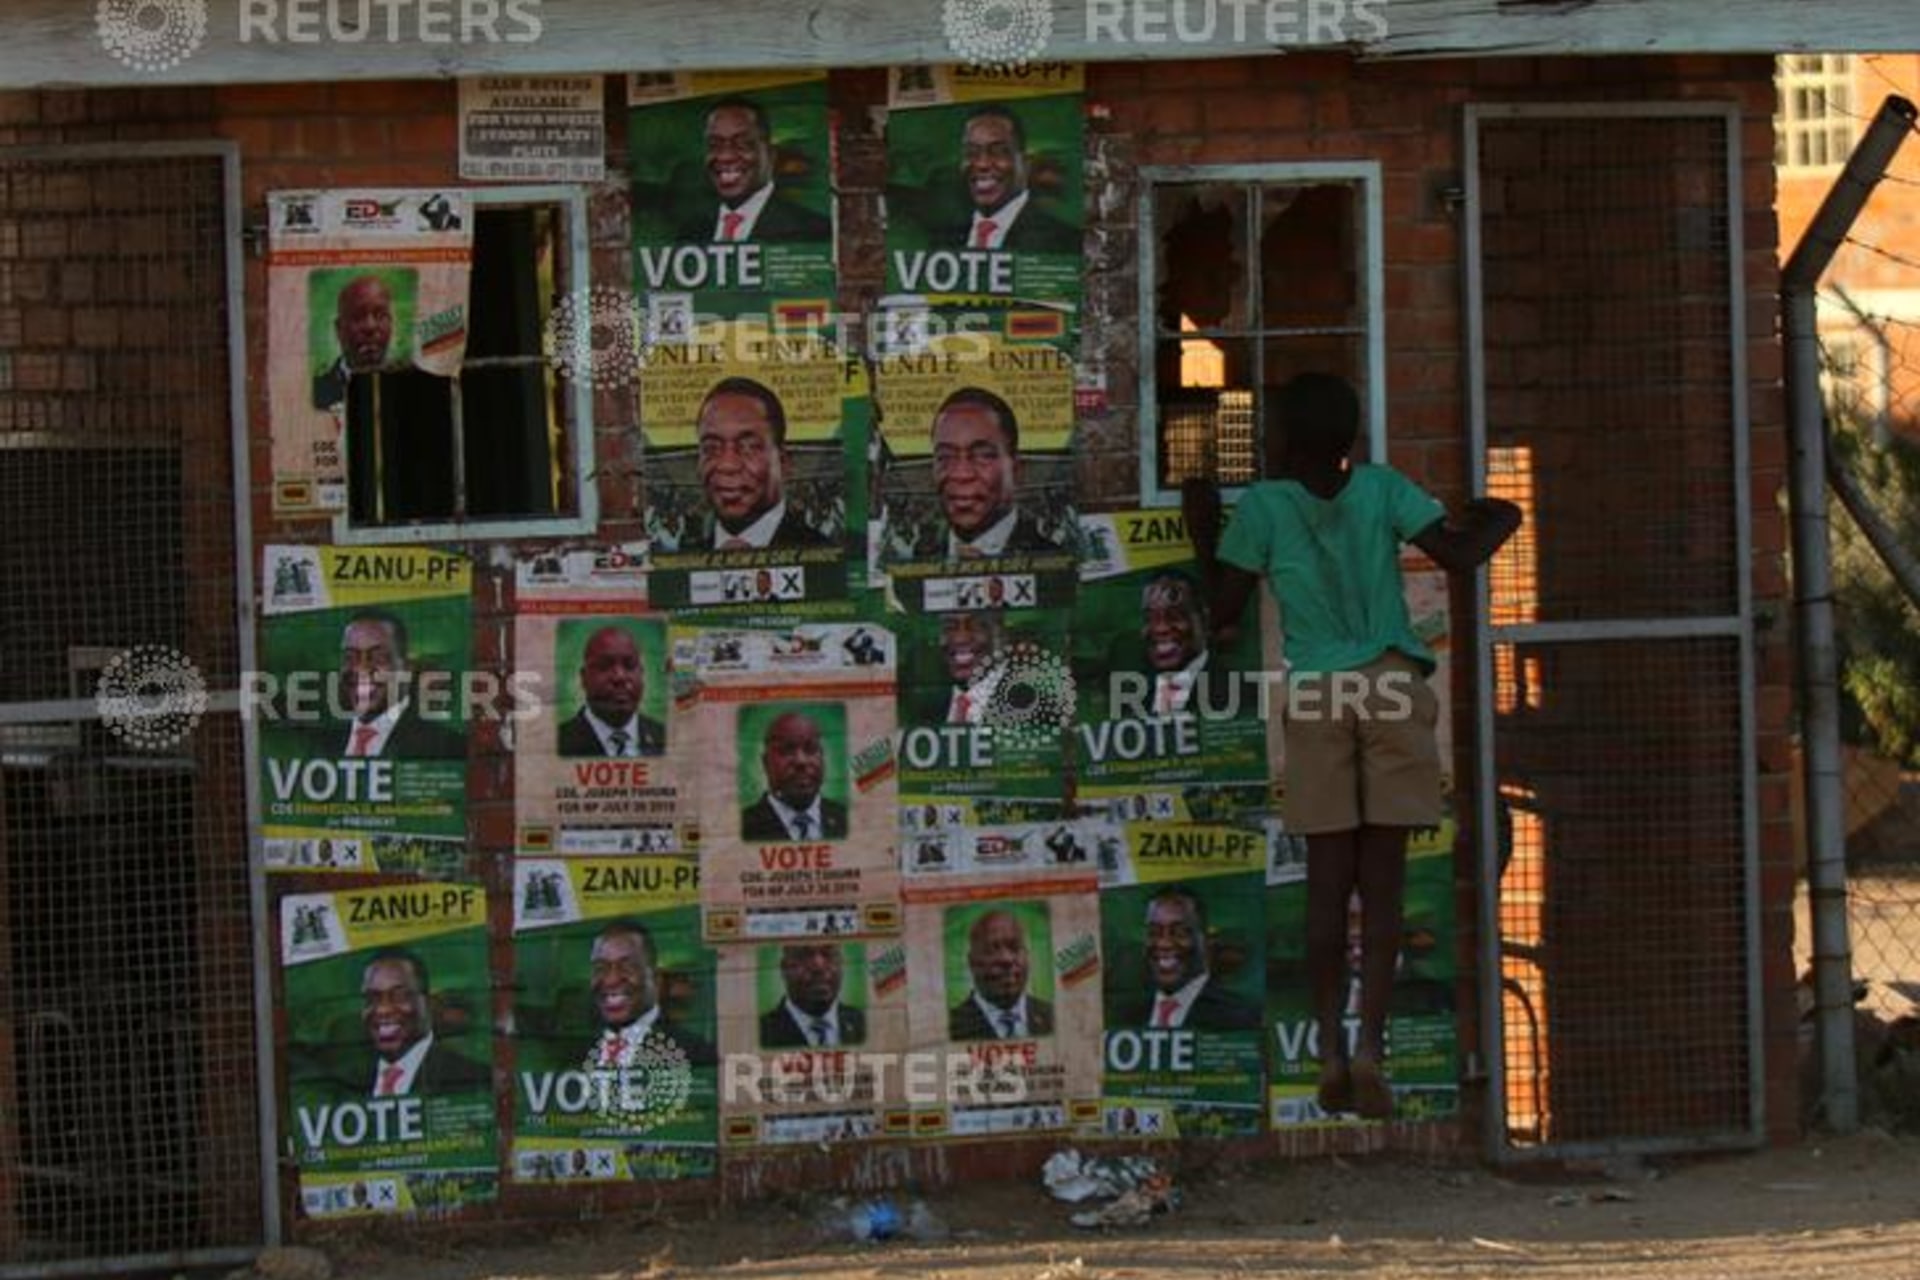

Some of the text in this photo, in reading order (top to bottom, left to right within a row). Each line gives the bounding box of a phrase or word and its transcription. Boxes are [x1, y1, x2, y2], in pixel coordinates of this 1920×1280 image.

[639, 243, 763, 288] VOTE
[893, 250, 1014, 293] VOTE
[333, 553, 462, 582] ZANU-PF
[1080, 712, 1200, 762] VOTE
[269, 758, 393, 802] VOTE
[576, 763, 648, 786] VOTE
[759, 845, 832, 870] VOTE
[1138, 833, 1257, 859] ZANU-PF
[348, 889, 476, 923] ZANU-PF
[1104, 1030, 1195, 1071] OTE
[521, 1066, 647, 1113] VOTE
[298, 1098, 424, 1147] VOTE
